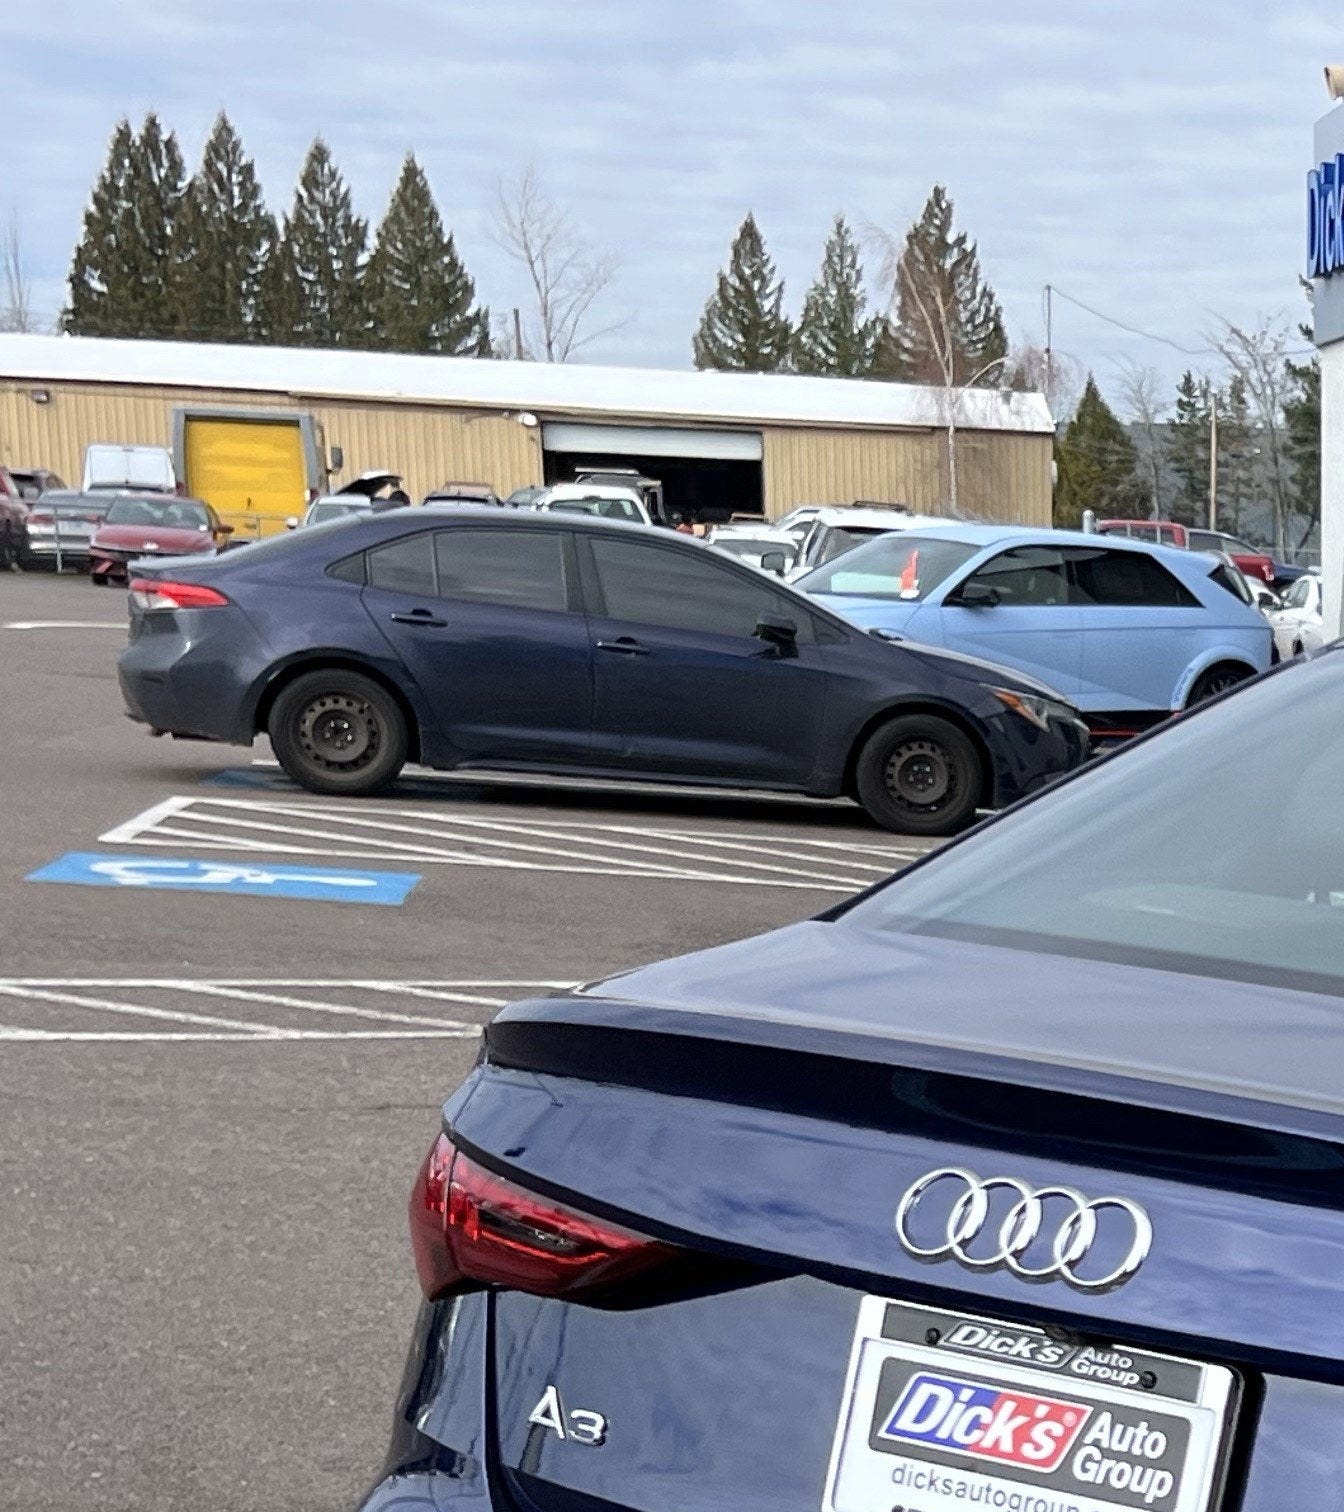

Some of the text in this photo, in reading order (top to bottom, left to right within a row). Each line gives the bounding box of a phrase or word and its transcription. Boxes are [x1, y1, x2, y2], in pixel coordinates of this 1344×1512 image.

[949, 1325, 1064, 1364] Dick's
[1079, 1346, 1133, 1370] Auto
[1070, 1359, 1140, 1386] Group
[528, 1385, 606, 1446] A3
[895, 1381, 1063, 1461] Dick's
[1083, 1411, 1167, 1460] Auto
[1072, 1445, 1175, 1503] Group
